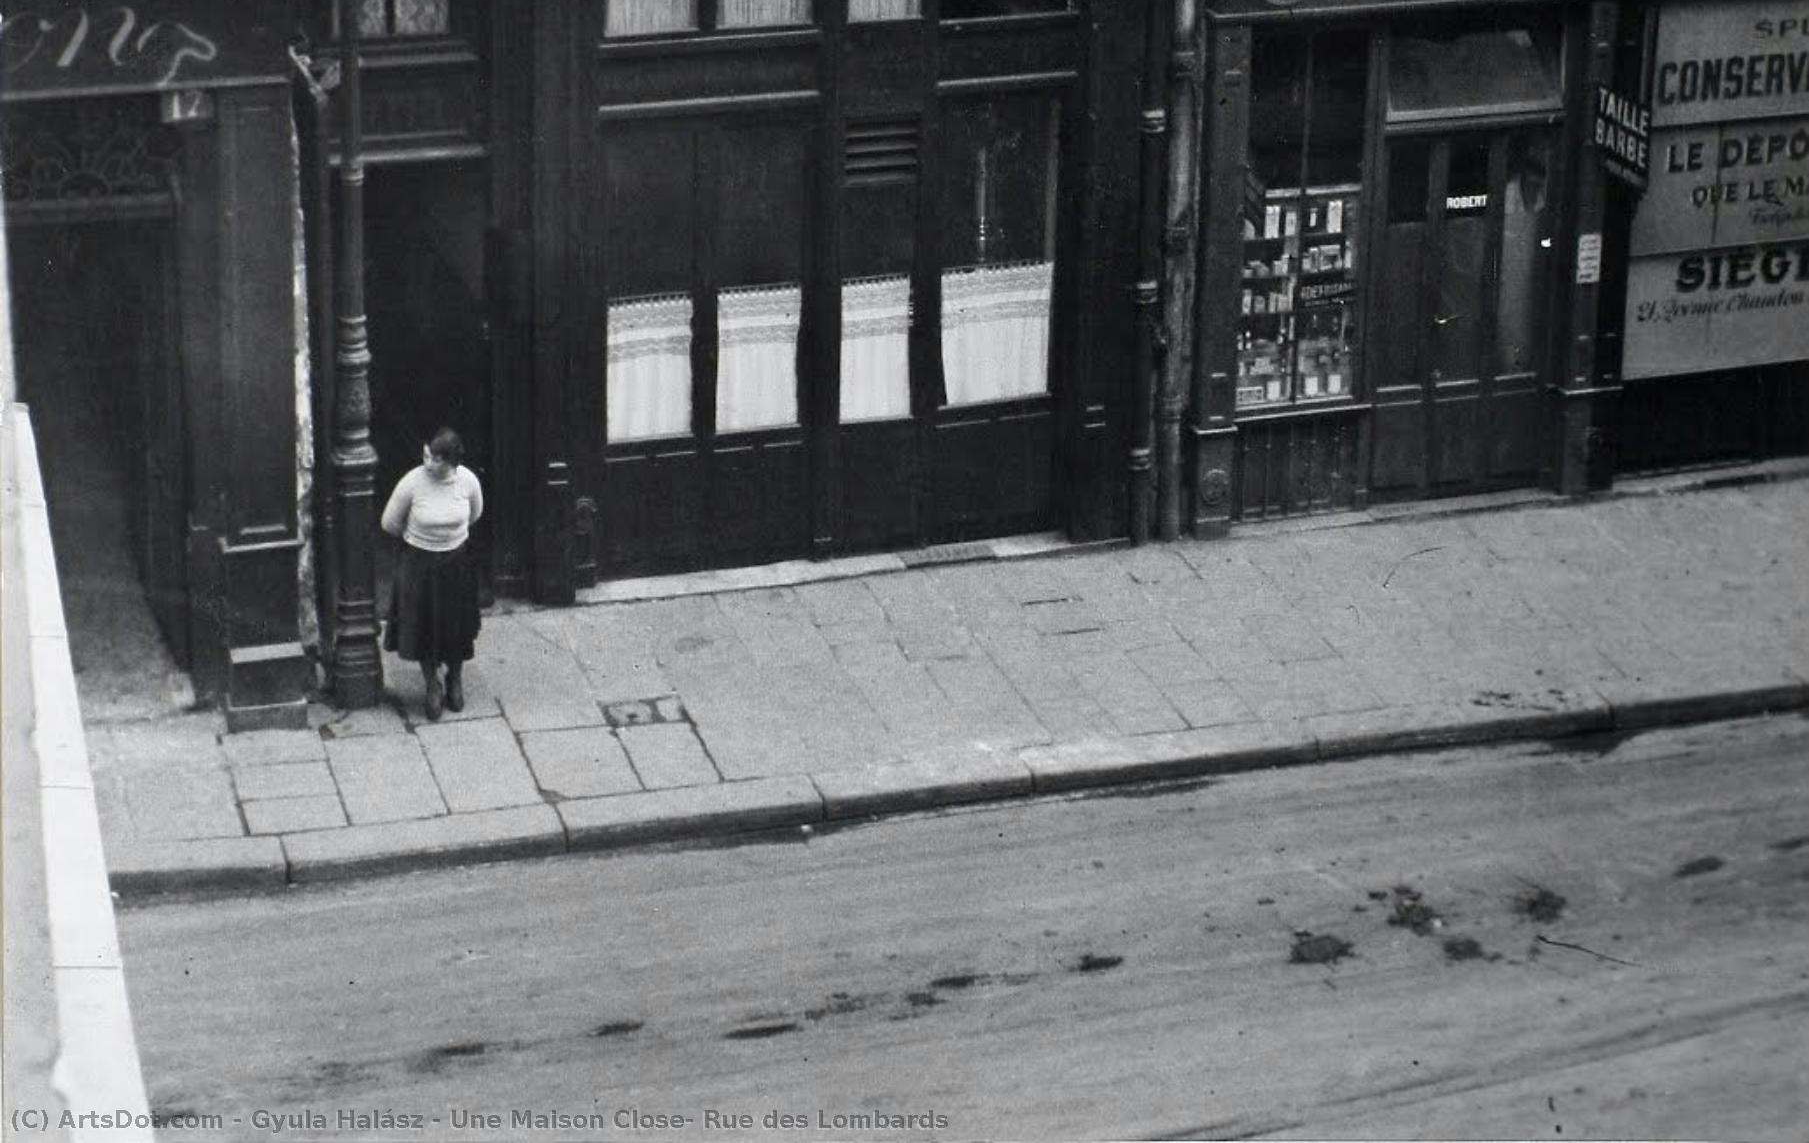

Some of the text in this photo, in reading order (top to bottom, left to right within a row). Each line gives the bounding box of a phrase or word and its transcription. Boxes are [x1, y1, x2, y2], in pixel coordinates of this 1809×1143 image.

[1658, 52, 1809, 106] CONSERV
[1599, 86, 1649, 137] TAILLE
[1595, 117, 1647, 168] BARBE
[1667, 143, 1704, 174] LE
[1446, 193, 1488, 210] ROBERT
[1692, 176, 1809, 208] QUE LE M
